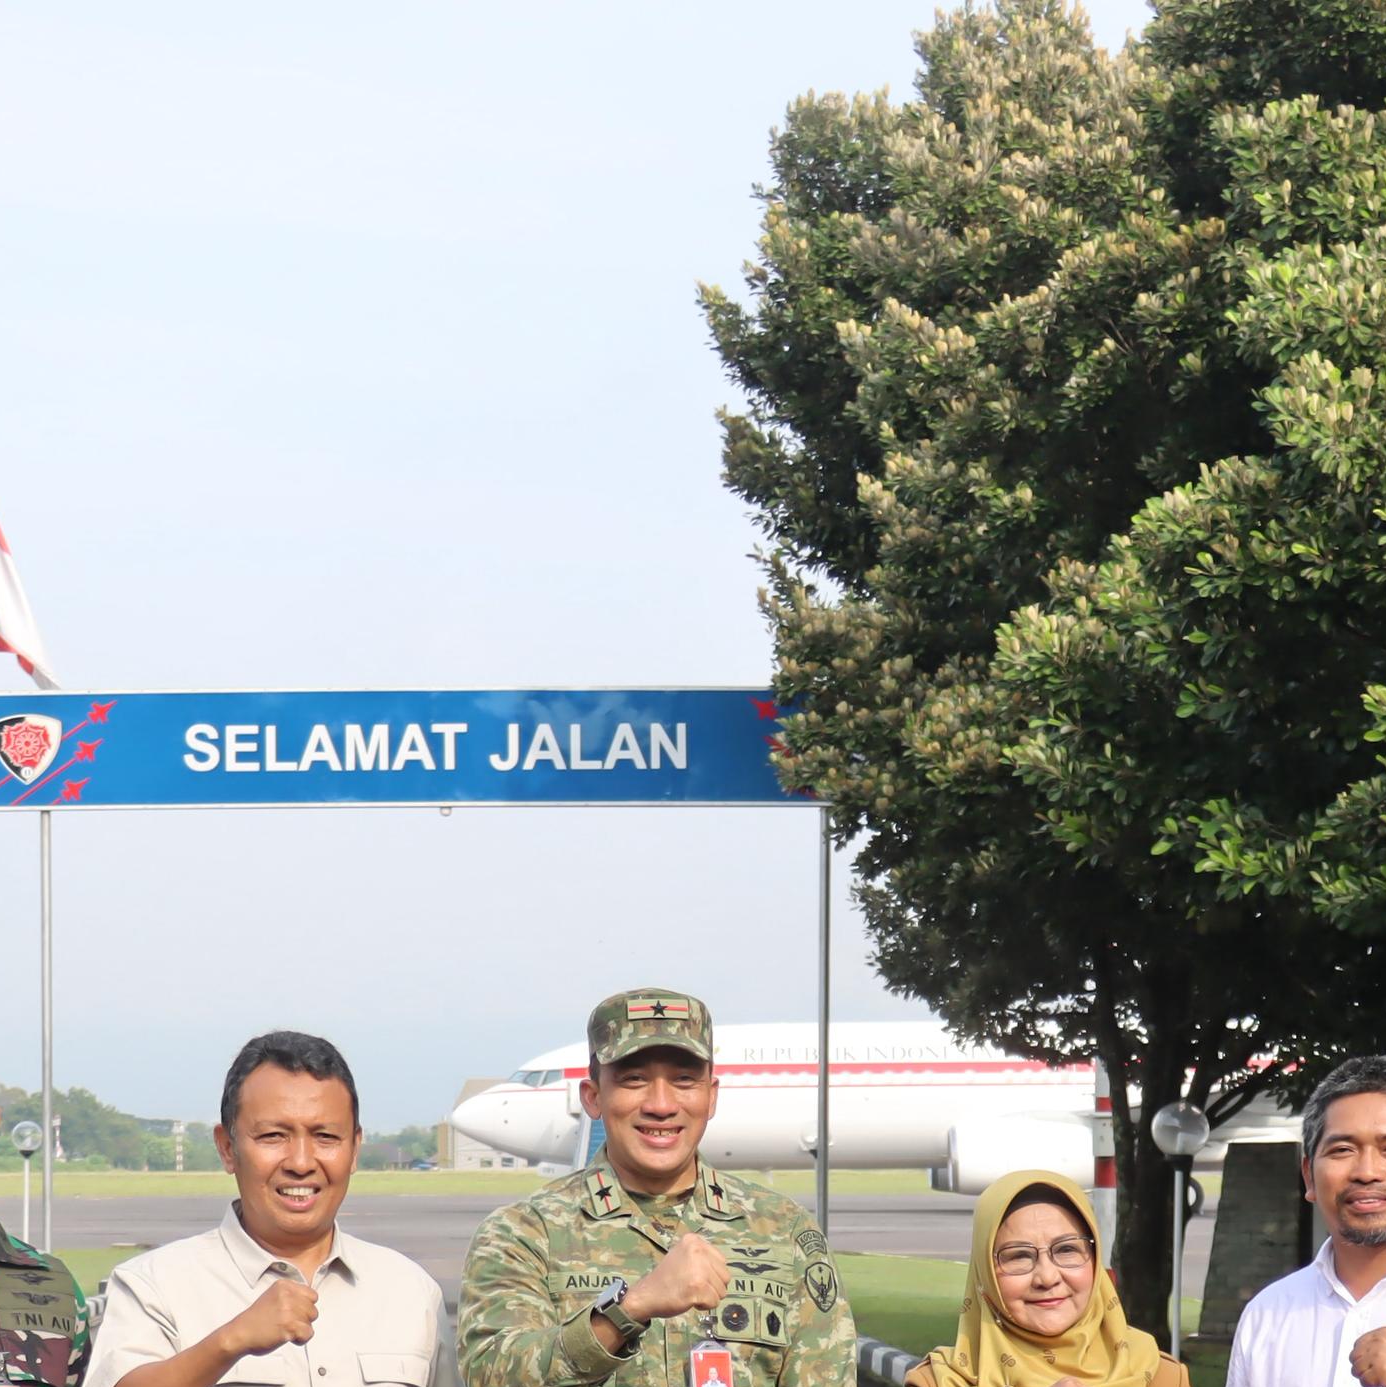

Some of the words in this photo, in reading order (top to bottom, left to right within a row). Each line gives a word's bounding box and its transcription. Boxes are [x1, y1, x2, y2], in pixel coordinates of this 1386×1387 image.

[183, 723, 467, 772] SELAMAT
[489, 723, 687, 770] JALAN
[744, 1047, 856, 1062] REPUBIK
[764, 1283, 784, 1298] AU
[13, 1312, 43, 1326] TNI
[52, 1316, 70, 1332] AU
